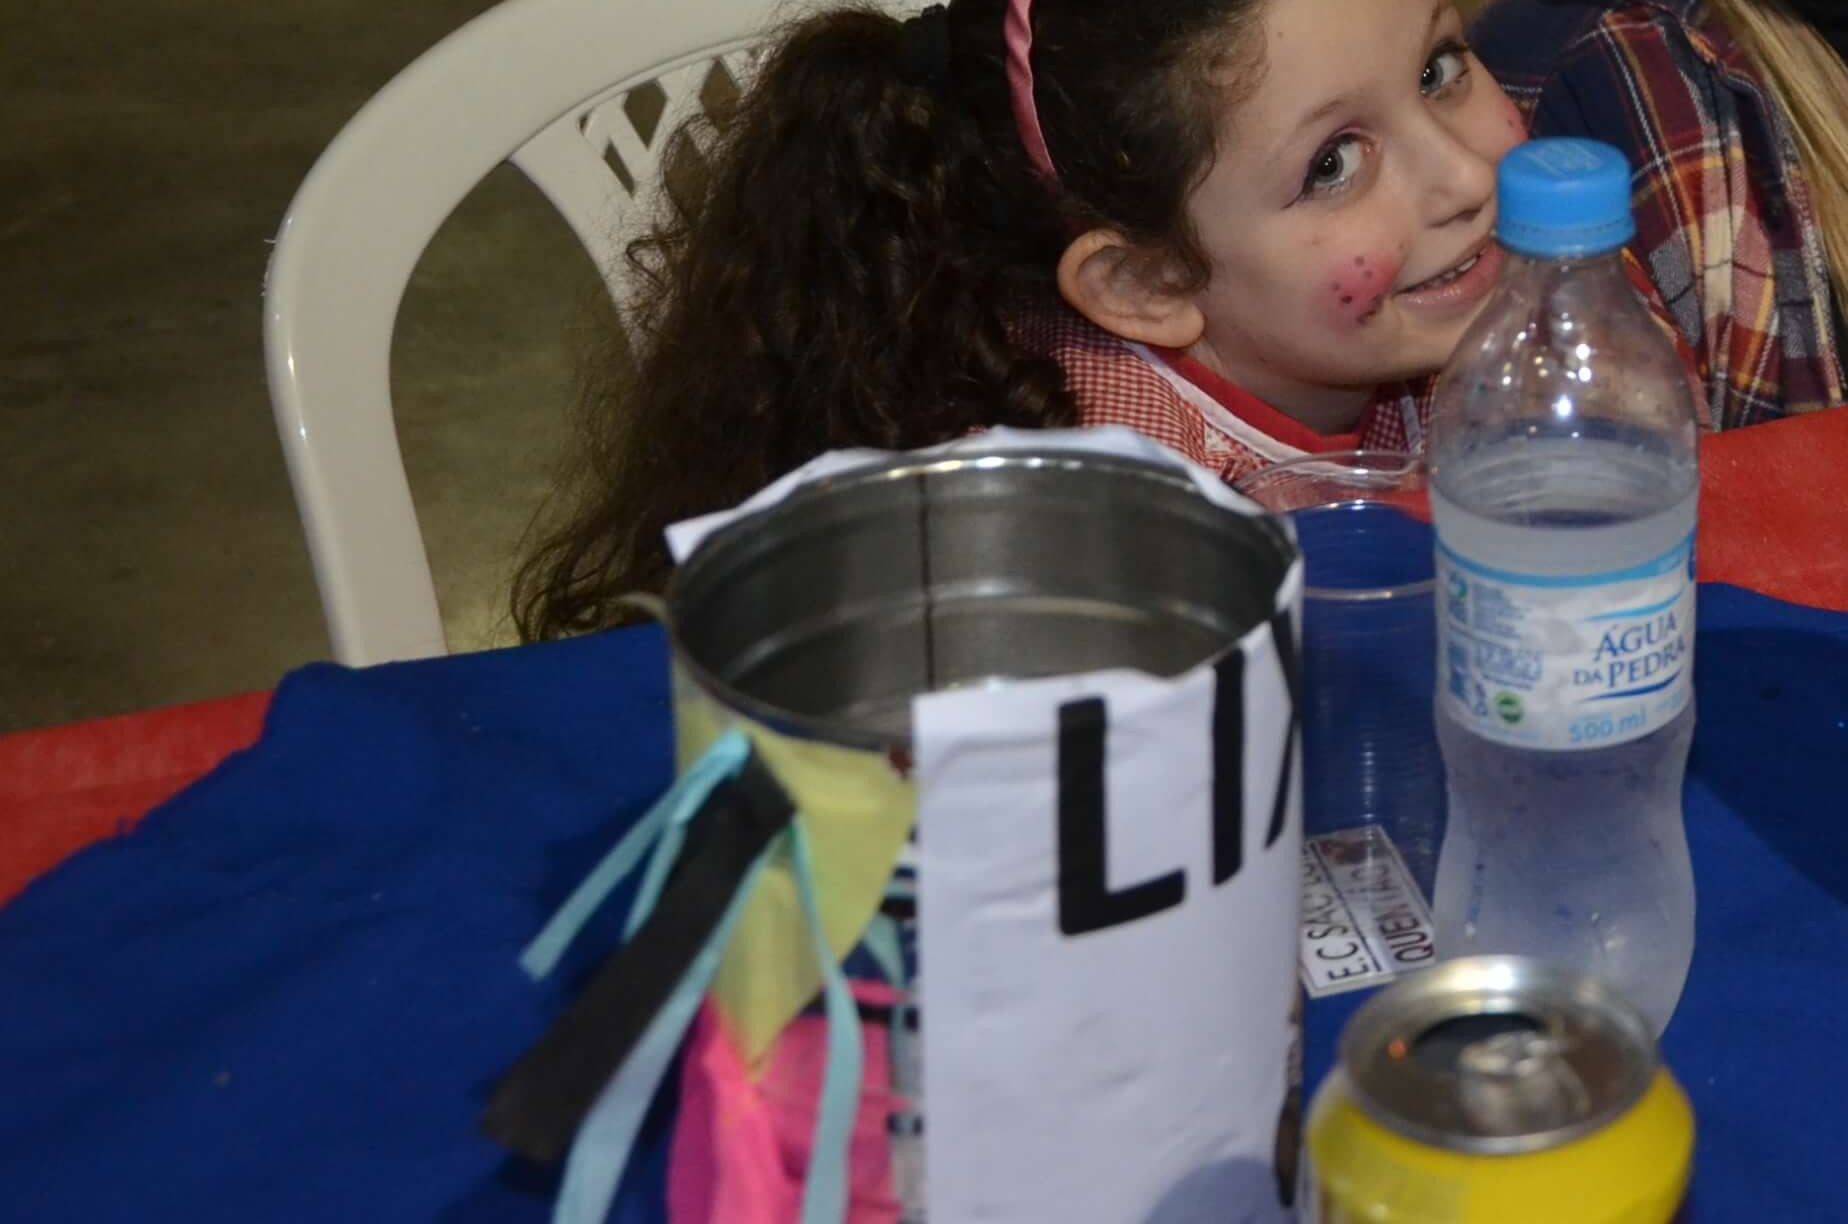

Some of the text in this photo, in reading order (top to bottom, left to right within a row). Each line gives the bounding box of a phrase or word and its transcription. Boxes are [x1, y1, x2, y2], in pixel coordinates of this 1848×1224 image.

[1573, 633, 1685, 688] DA PEDRA
[1593, 612, 1676, 662] ÁGUA
